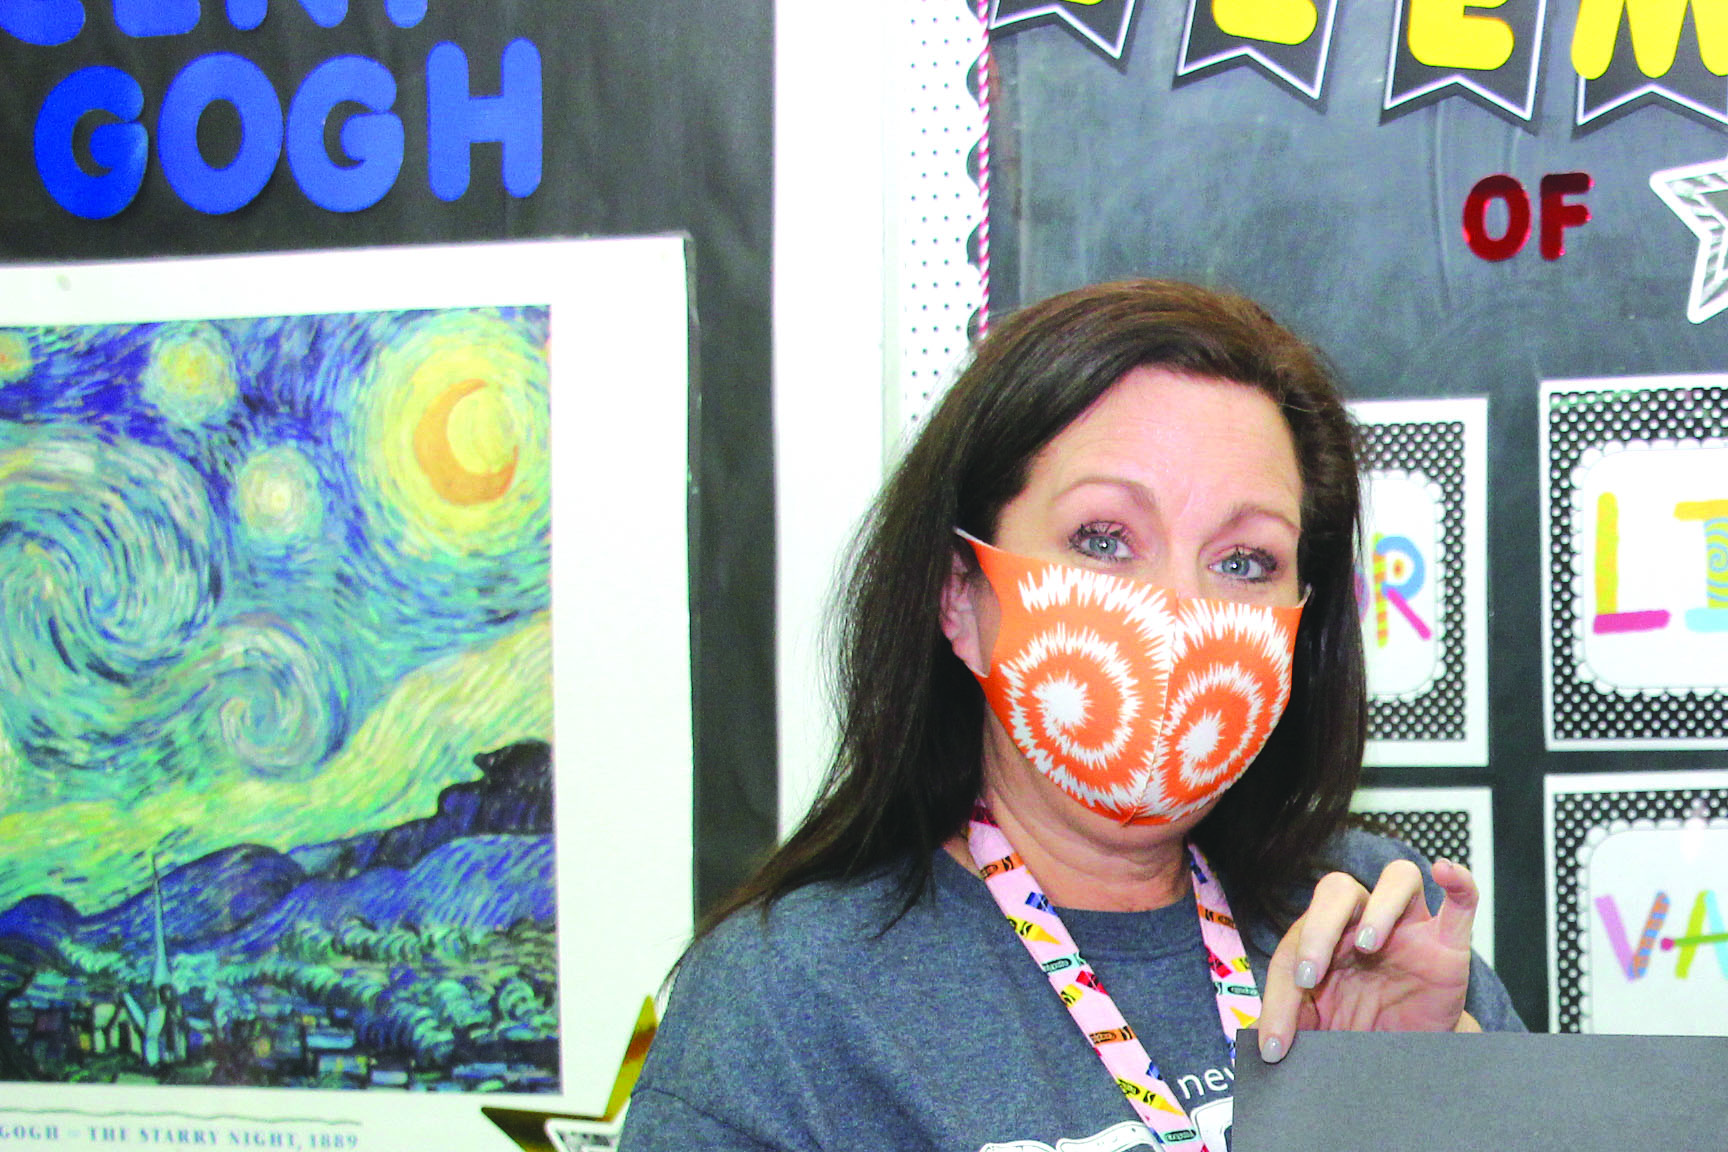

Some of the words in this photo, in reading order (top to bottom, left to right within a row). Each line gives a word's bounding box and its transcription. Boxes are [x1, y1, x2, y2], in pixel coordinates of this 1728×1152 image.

[33, 38, 543, 220] GOGH
[1462, 172, 1594, 262] OF
[0, 1125, 59, 1141] GOGH
[89, 1126, 130, 1142] THE
[138, 1127, 219, 1145] STARRY
[310, 1133, 359, 1149] 1889
